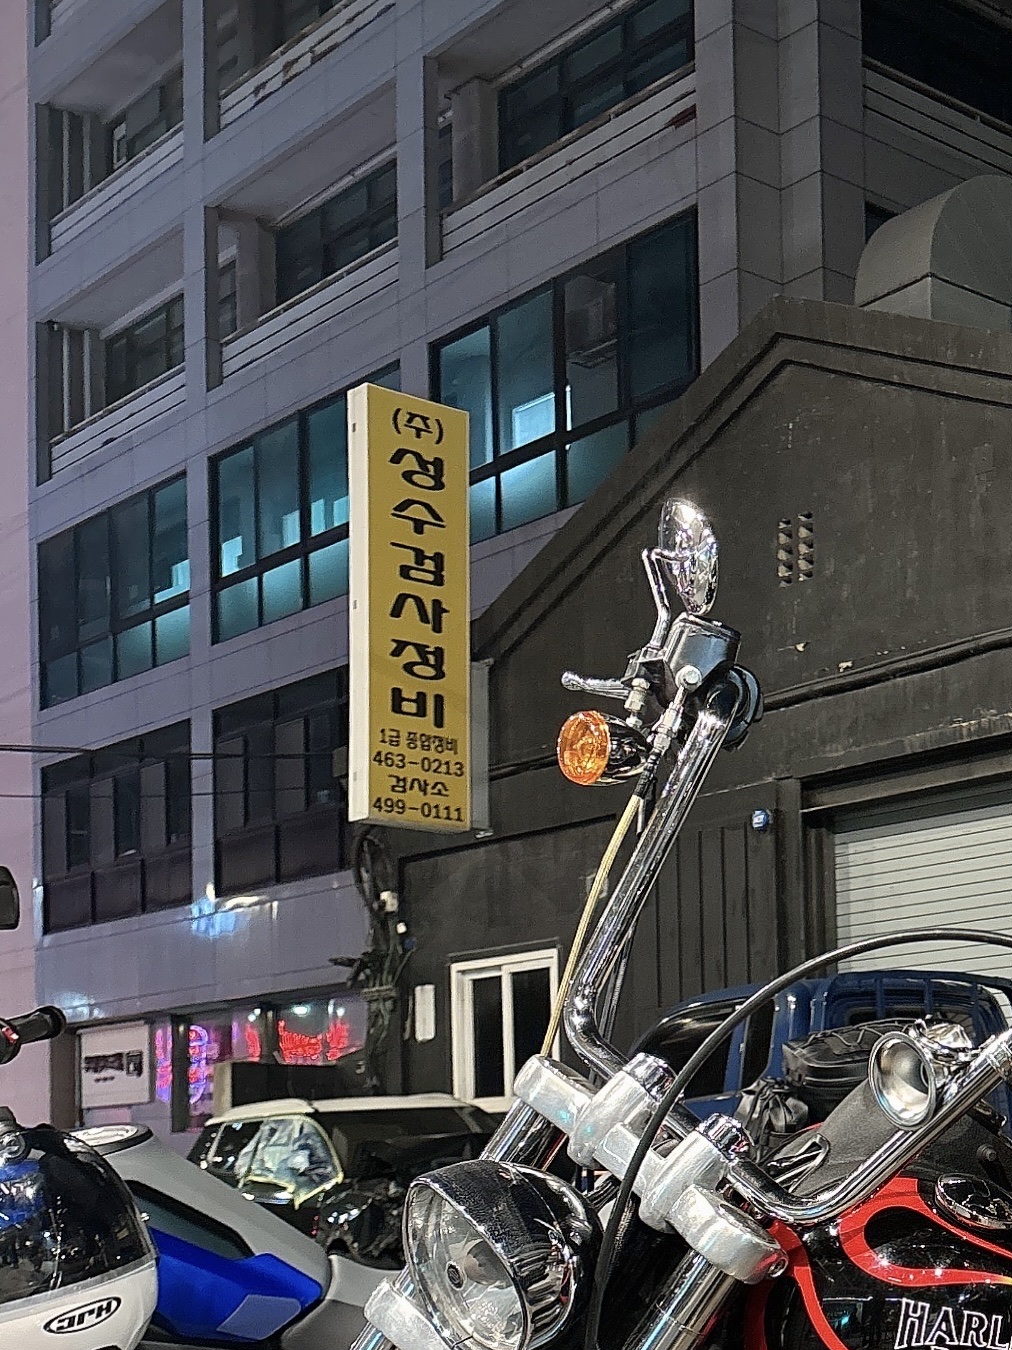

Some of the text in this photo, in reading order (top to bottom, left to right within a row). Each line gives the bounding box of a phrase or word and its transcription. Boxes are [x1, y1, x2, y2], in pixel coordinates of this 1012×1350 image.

[372, 750, 465, 777] 463-0213
[388, 773, 449, 797] 검사소
[372, 797, 465, 822] 499-0111
[55, 1300, 113, 1331] HJC
